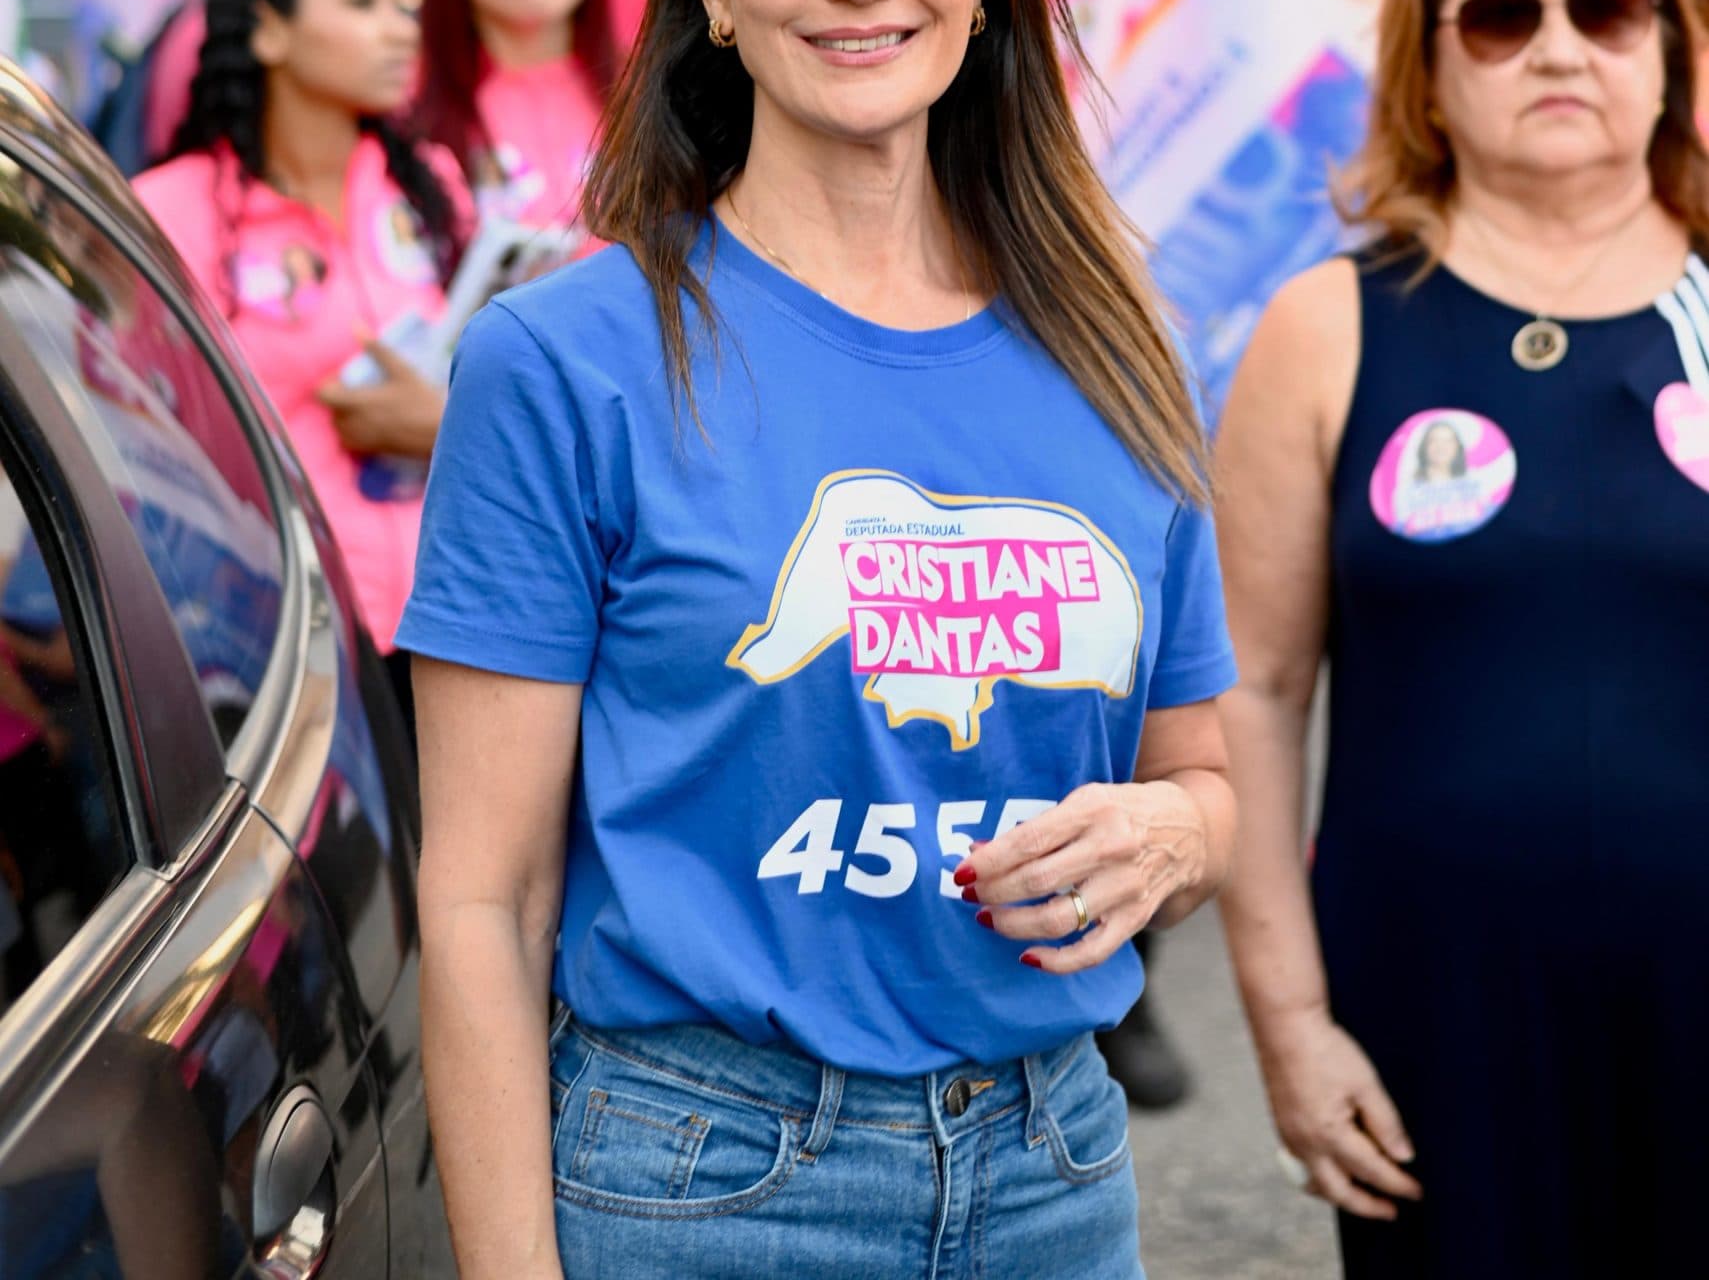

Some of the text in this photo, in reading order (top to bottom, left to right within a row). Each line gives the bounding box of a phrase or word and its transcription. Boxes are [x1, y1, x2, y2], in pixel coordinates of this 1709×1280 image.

[845, 522, 965, 537] DEPUTADA ESTADUAL
[843, 540, 1098, 603] CRISTIANE
[853, 609, 1045, 673] DANTAS
